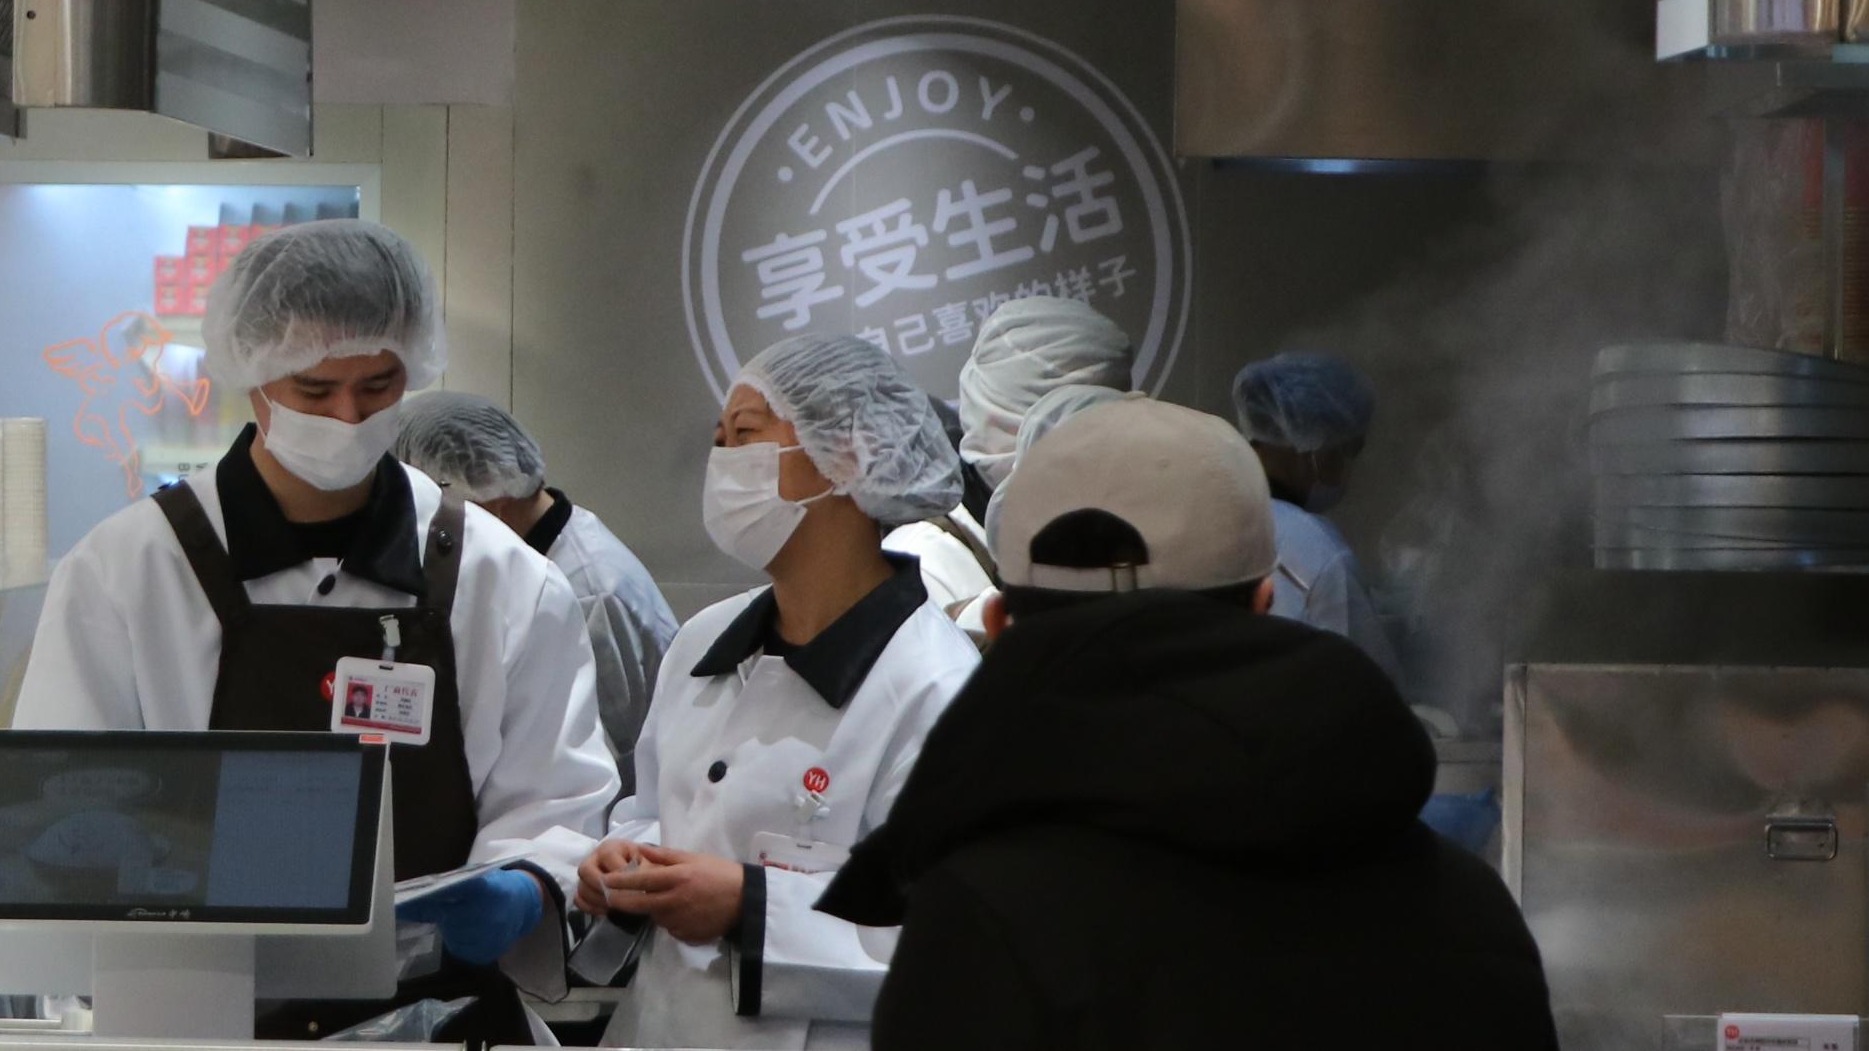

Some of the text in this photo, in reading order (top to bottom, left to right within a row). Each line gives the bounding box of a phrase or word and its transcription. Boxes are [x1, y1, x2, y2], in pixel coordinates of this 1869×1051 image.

[787, 69, 1013, 170] ENJOY
[741, 144, 1124, 332] 享受生活
[808, 770, 827, 790] YH
